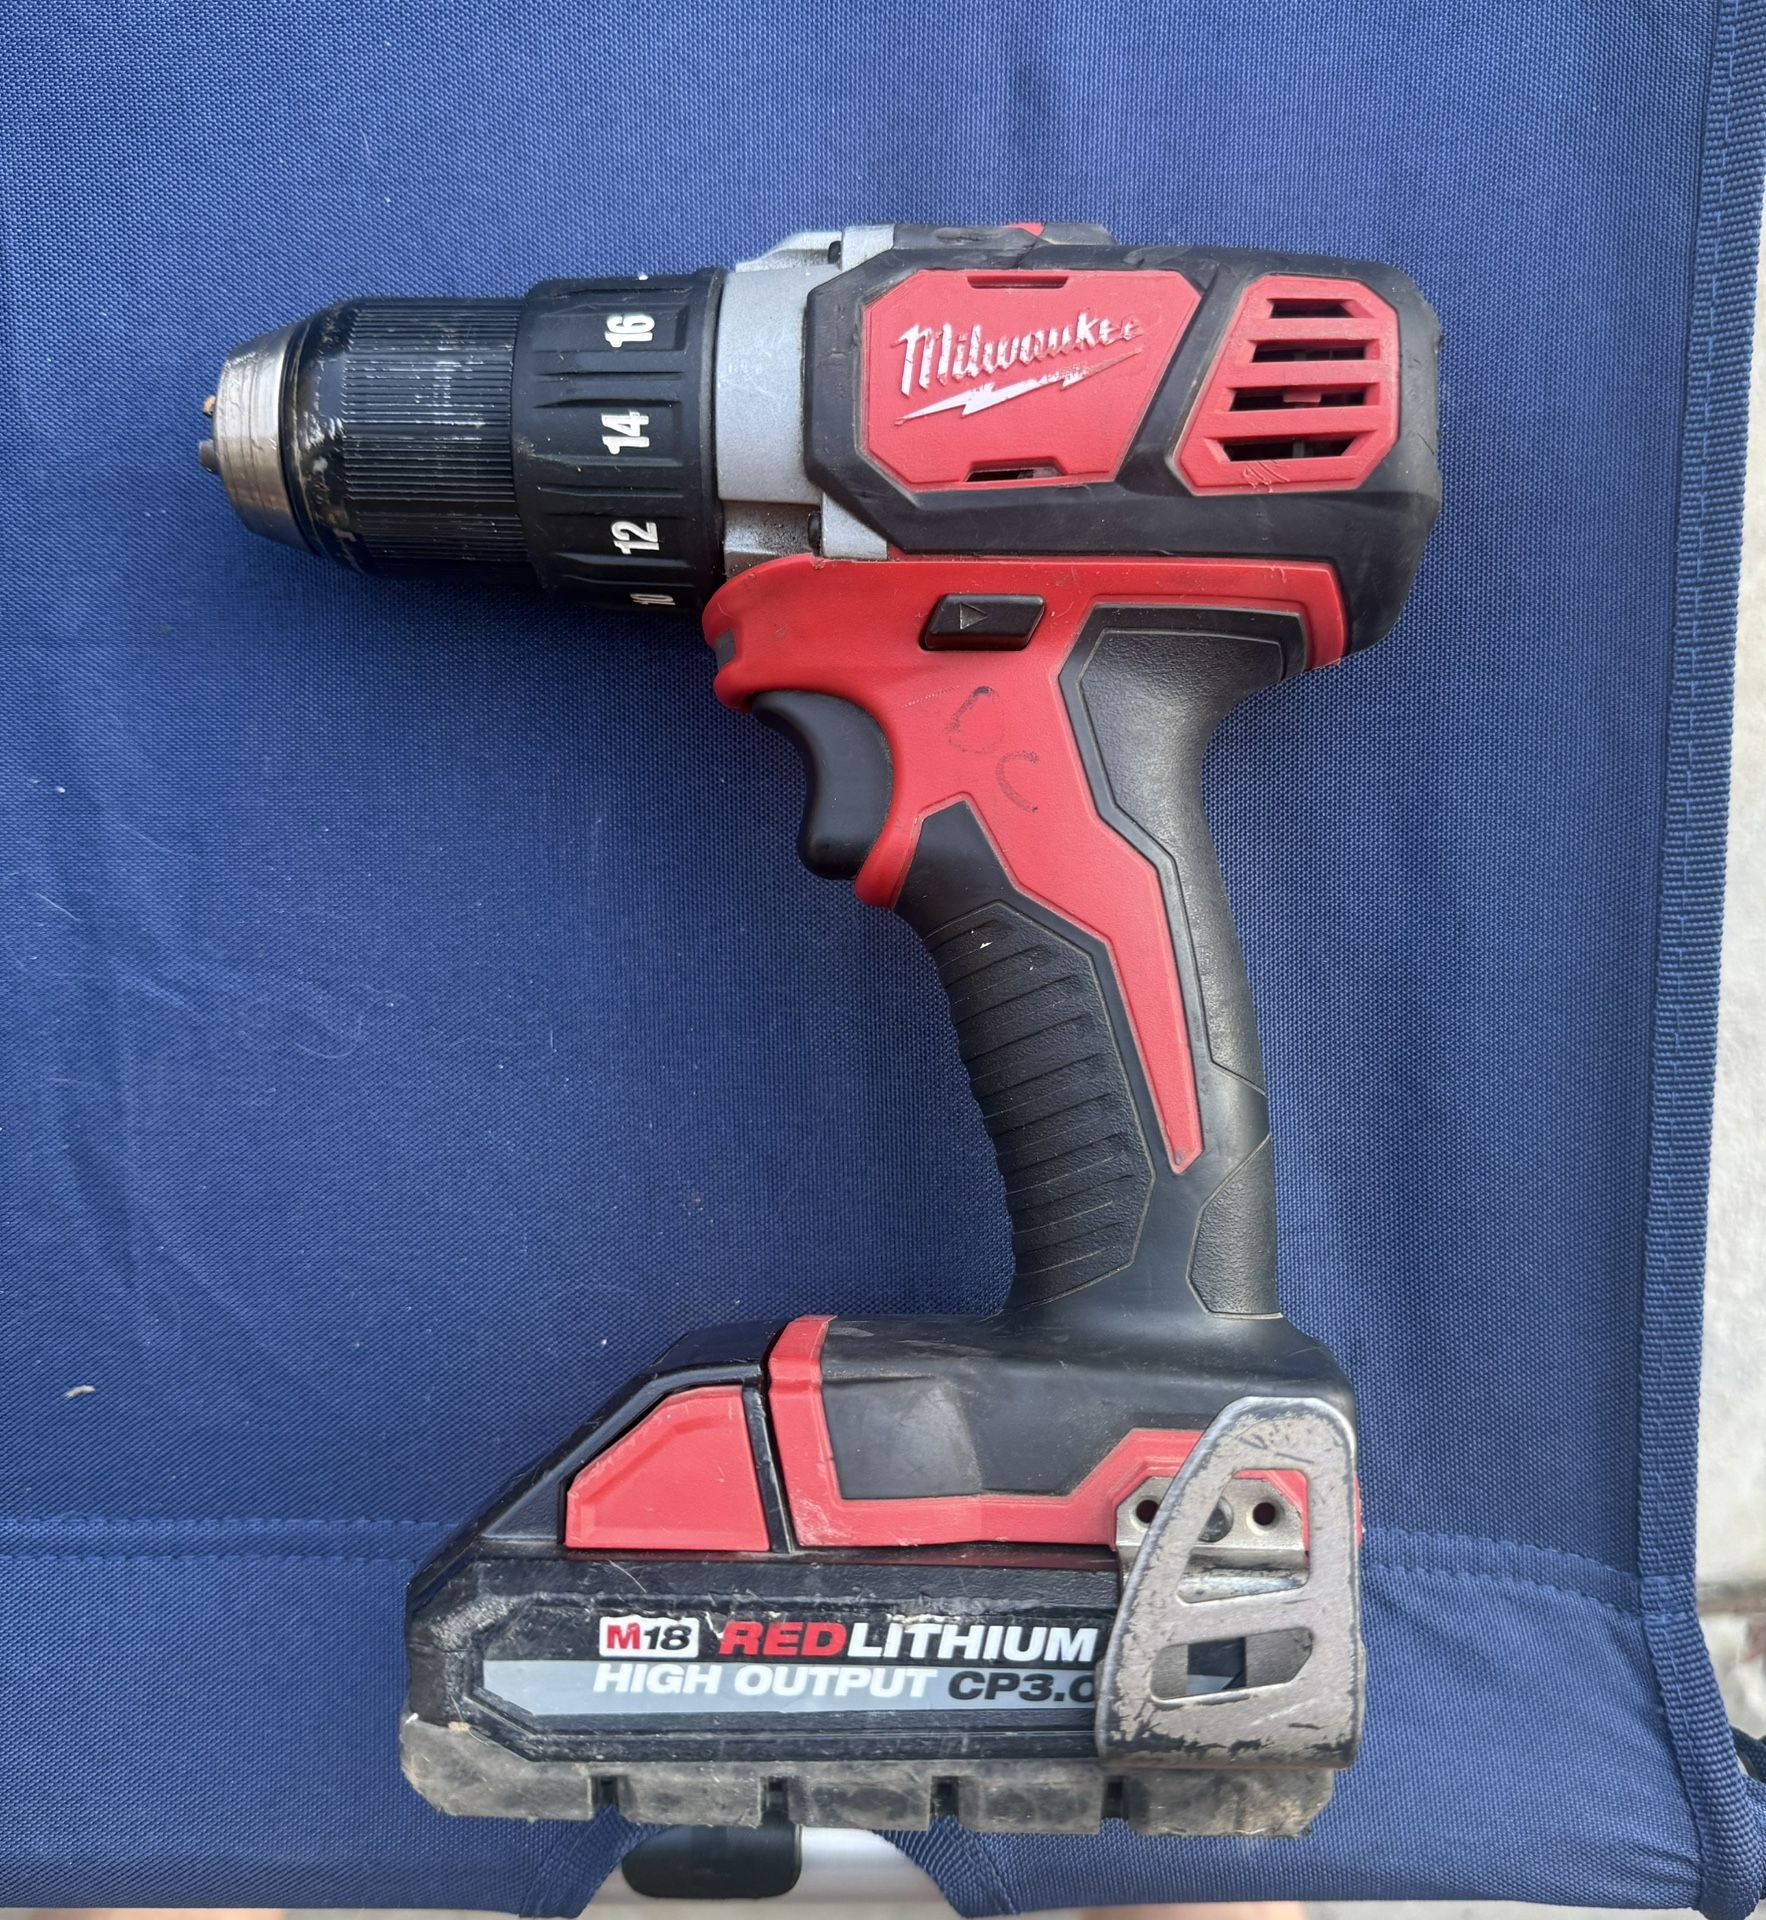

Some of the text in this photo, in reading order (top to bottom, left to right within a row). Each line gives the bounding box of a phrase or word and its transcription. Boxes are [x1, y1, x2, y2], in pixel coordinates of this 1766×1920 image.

[604, 313, 656, 348] 16
[891, 307, 1144, 398] Milwaukee
[601, 411, 650, 455] 14
[611, 520, 660, 555] 12
[605, 1620, 1099, 1662] M18 REDLITHIUM
[593, 1662, 722, 1695] HIGH
[734, 1666, 938, 1699] OUTPUT
